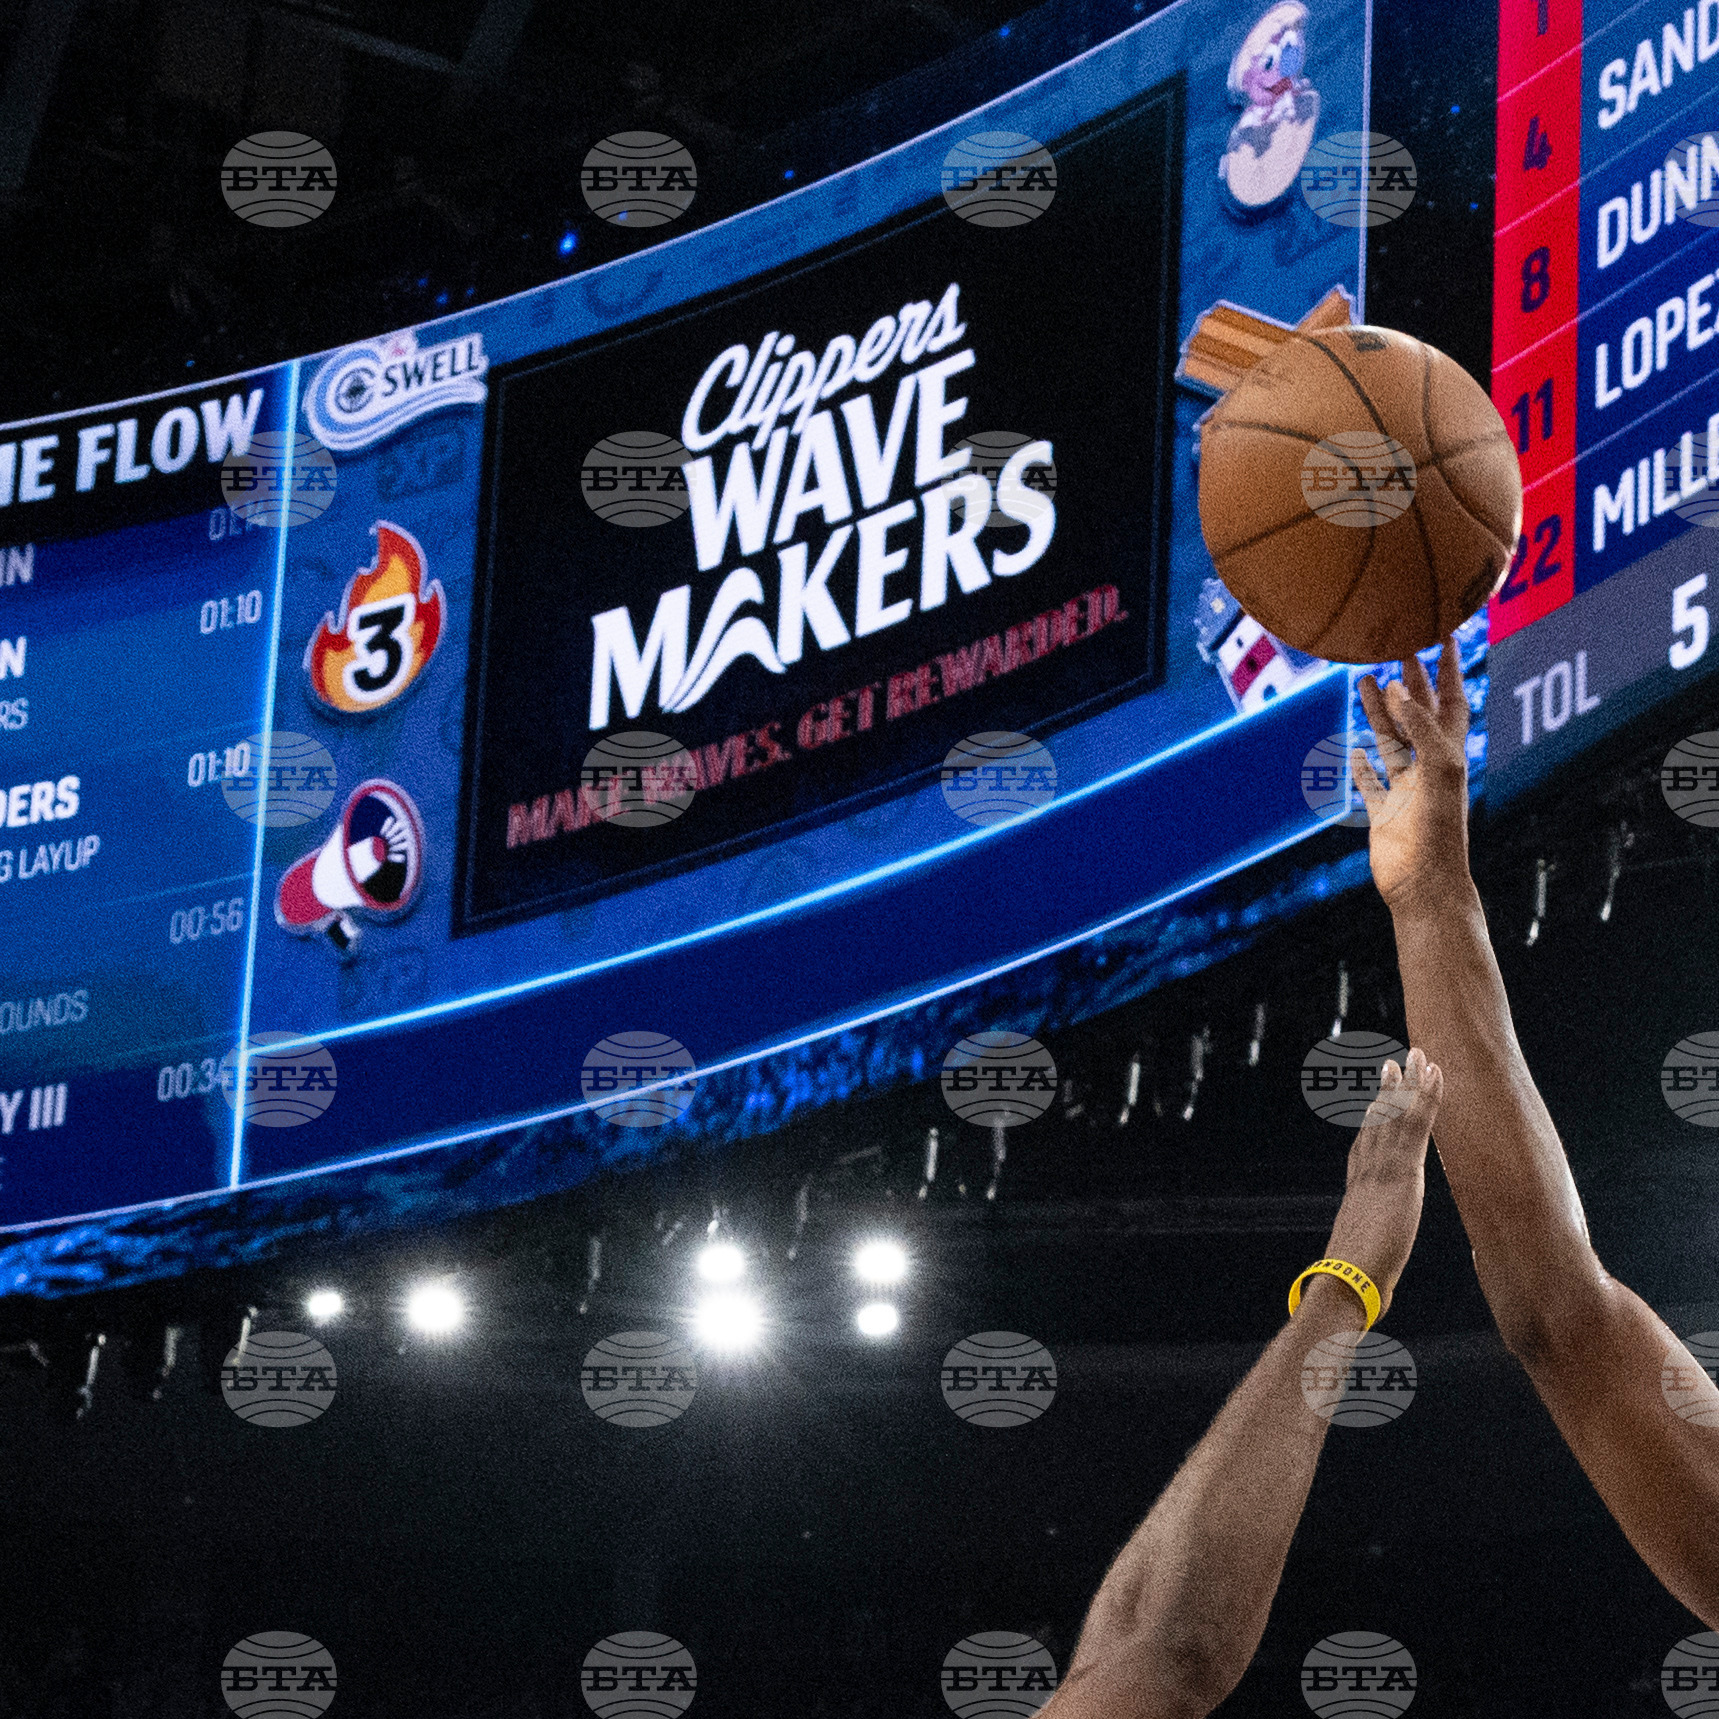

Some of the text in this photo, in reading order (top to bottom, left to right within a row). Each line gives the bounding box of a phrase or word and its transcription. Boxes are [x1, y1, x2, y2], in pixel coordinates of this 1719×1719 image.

[1522, 114, 1553, 173] 4
[1520, 246, 1551, 313] 8
[383, 340, 481, 398] SWELL
[682, 282, 967, 452] Clippers
[75, 388, 264, 492] FLOW
[1511, 379, 1554, 455] 11
[683, 348, 976, 573] WAVE
[589, 440, 1057, 731] MAKERS
[353, 603, 406, 693] 3
[1514, 573, 1711, 746] TOL 5
[797, 681, 881, 751] GET
[18, 835, 101, 880] LAYUP
